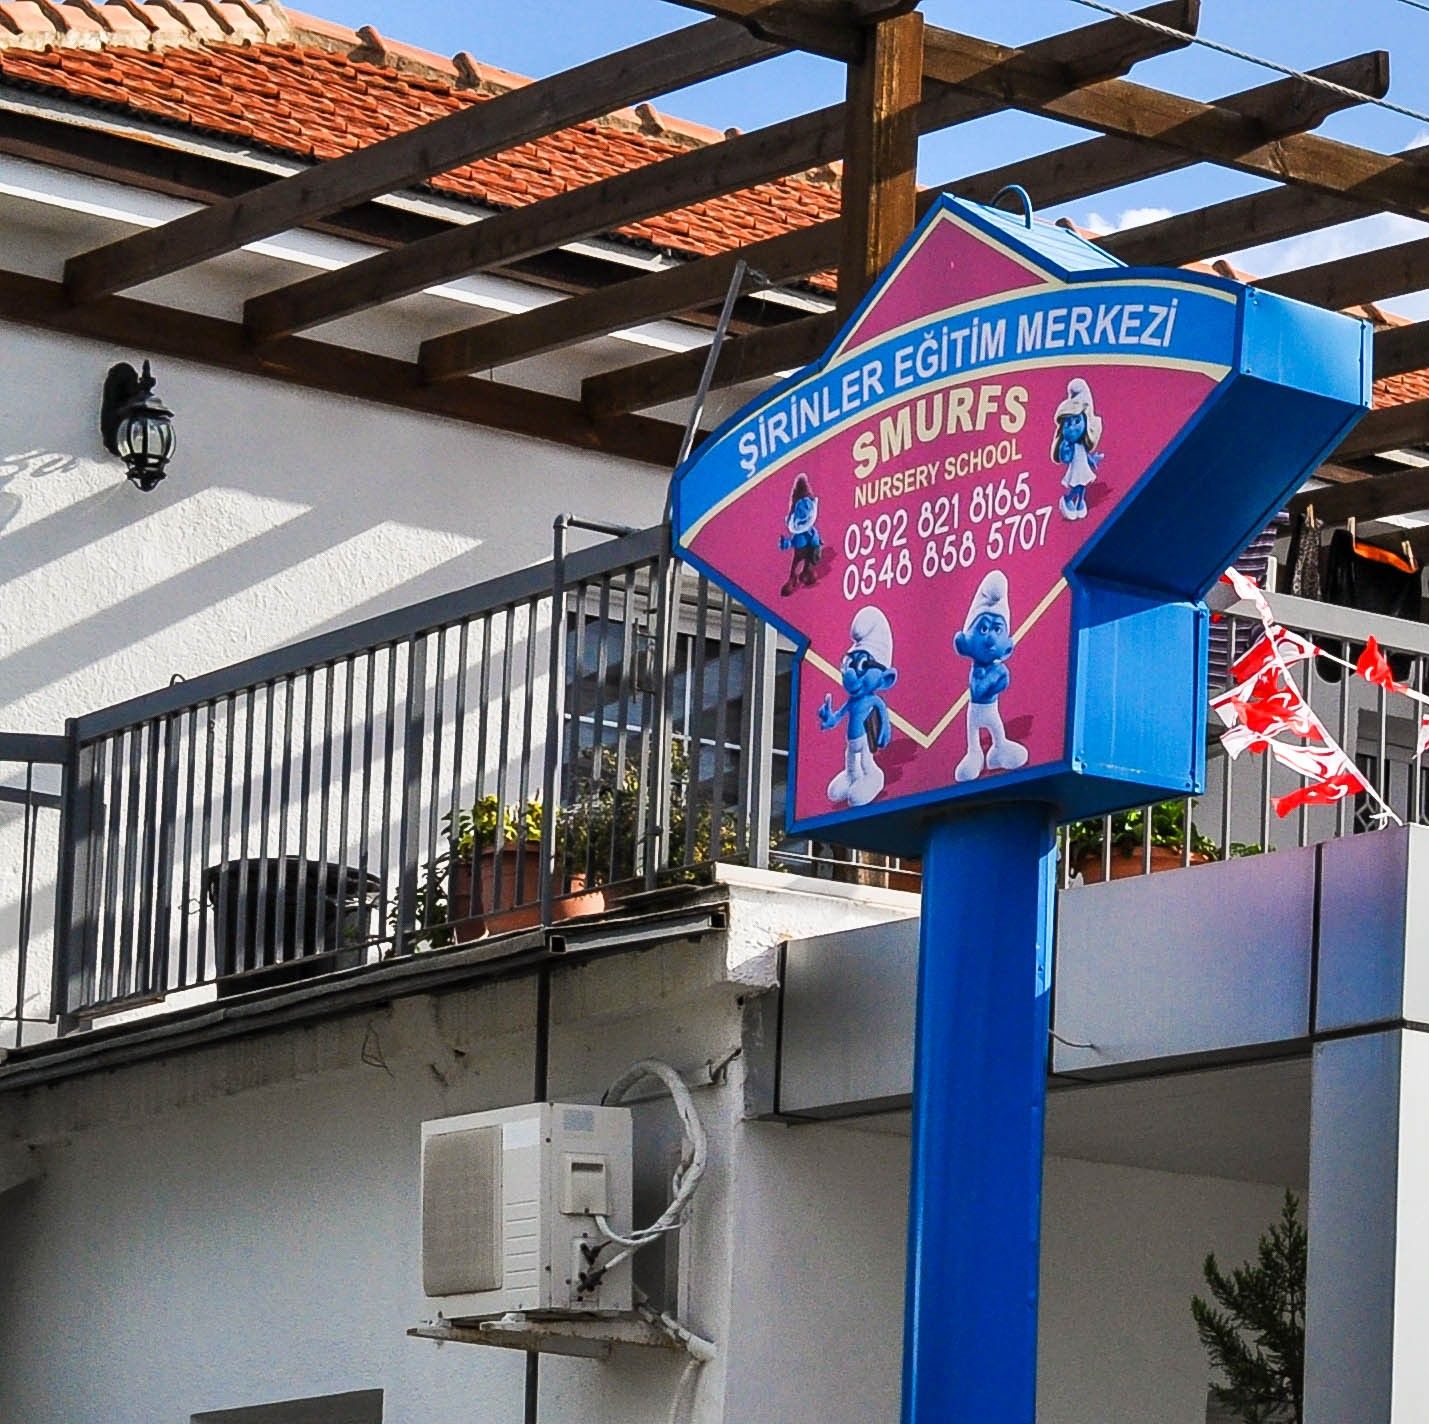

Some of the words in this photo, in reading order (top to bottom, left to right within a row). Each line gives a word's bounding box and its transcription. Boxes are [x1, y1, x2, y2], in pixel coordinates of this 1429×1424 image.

[738, 359, 885, 479] ŞİRİNLER
[894, 316, 1007, 388] EĞİTİM
[1016, 297, 1179, 354] MERKEZİ
[852, 384, 1029, 480] SMURFS
[844, 508, 908, 560] 0392
[917, 492, 960, 538] 821
[969, 471, 1031, 523] 8165
[854, 461, 940, 508] NURSERY
[944, 438, 1022, 480] SCHOOL
[843, 548, 912, 600] 0548
[922, 530, 976, 578] 858
[986, 505, 1053, 560] 5707
